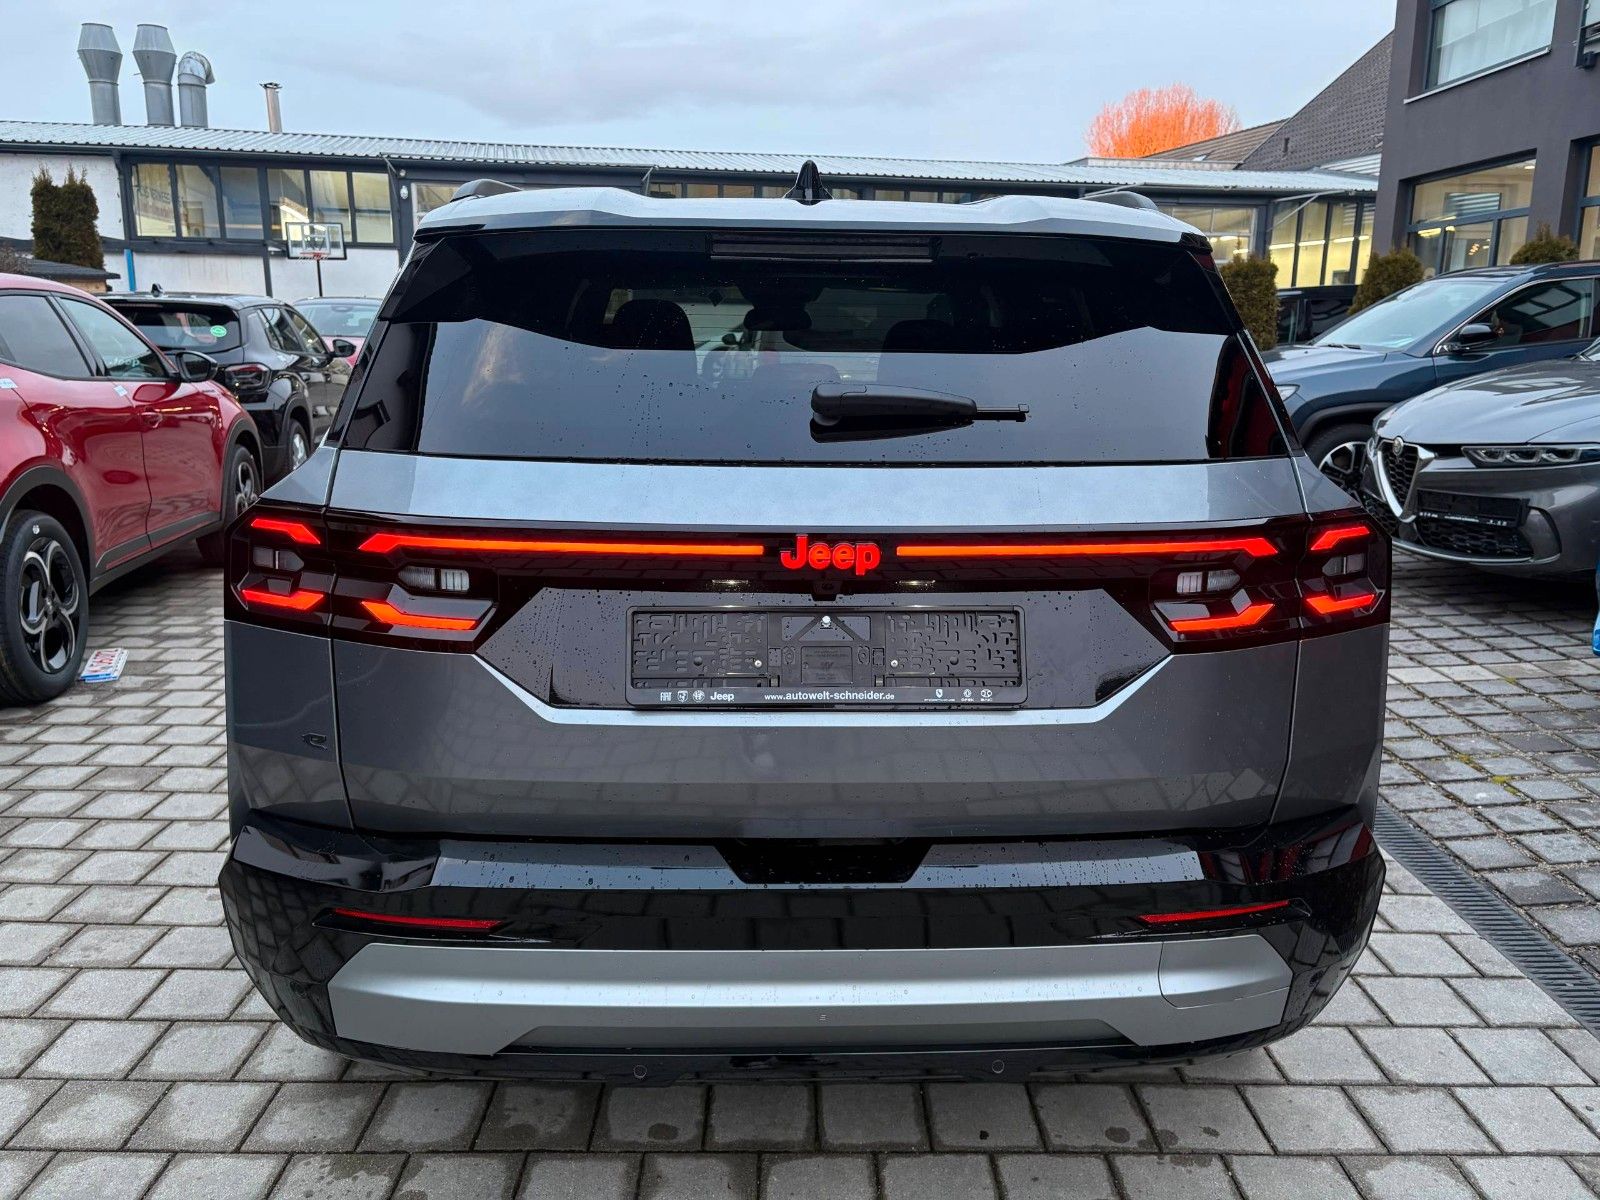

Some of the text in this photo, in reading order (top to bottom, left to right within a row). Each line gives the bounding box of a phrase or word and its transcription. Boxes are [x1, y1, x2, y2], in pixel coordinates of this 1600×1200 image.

[780, 534, 880, 575] Jeep
[710, 691, 735, 702] Jeep
[764, 690, 895, 700] www.autowelt-schneider.de
